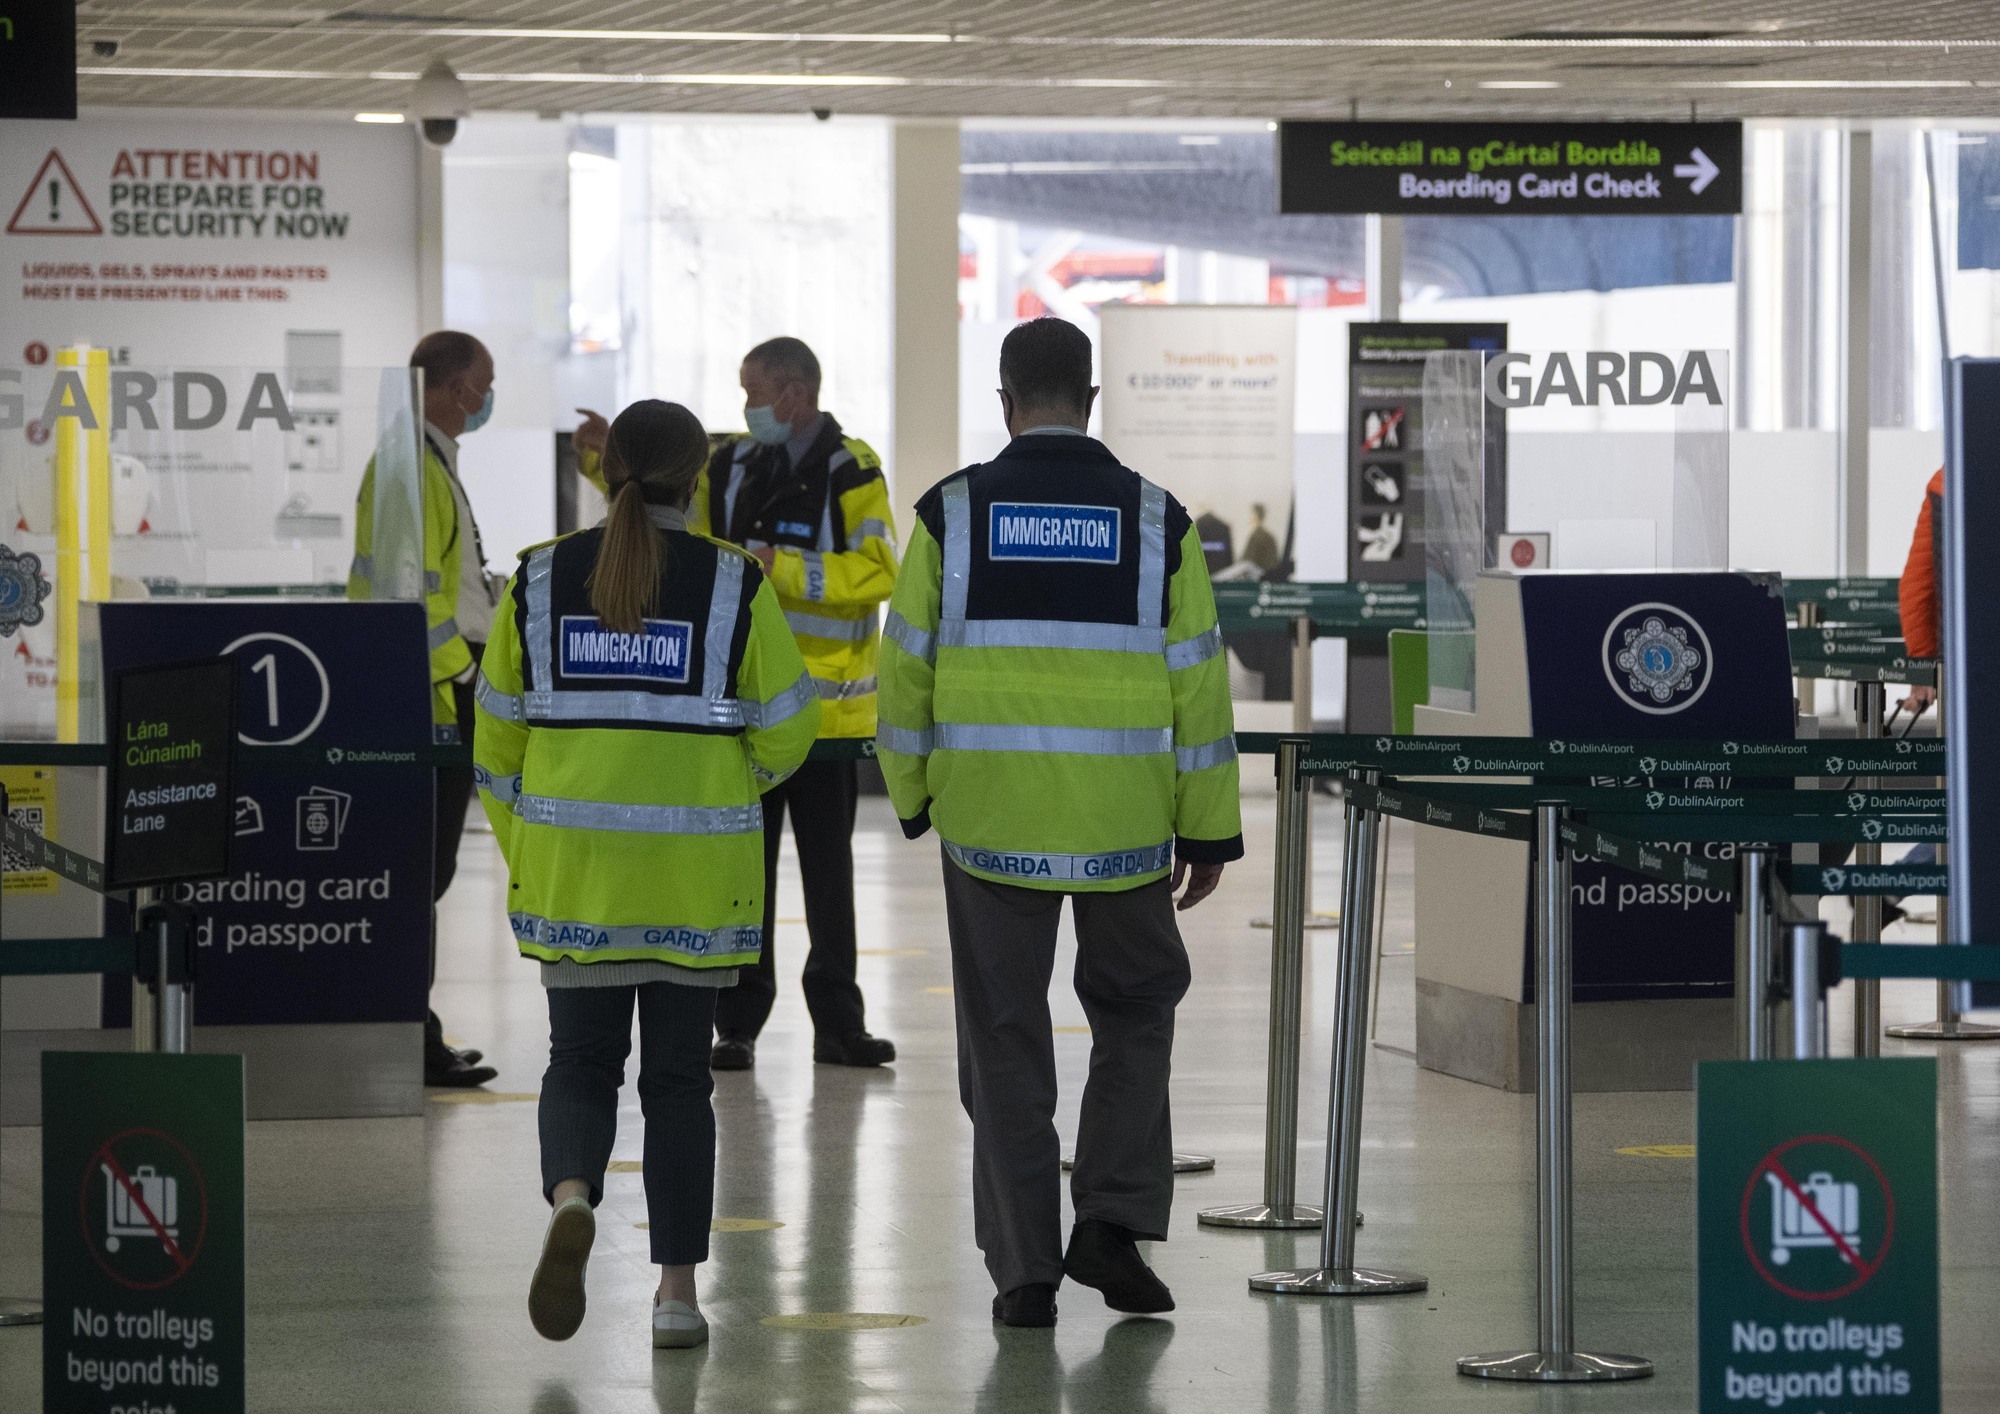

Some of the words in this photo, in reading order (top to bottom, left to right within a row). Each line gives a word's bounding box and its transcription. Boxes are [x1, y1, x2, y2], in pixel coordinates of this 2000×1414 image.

[111, 150, 320, 181] ATTENTION
[1331, 140, 1423, 166] Seiceáil
[1430, 146, 1461, 166] na
[1566, 140, 1661, 166] Bordála
[111, 183, 253, 210] PREPARE
[262, 184, 324, 210] FOR
[1400, 172, 1512, 204] Boarding
[1518, 172, 1578, 198] Card
[1584, 172, 1661, 198] Check
[111, 211, 266, 238] SECURITY
[275, 212, 349, 238] NOW
[22, 263, 95, 282] LIQUIDS,
[151, 265, 219, 281] SPRAYS
[222, 265, 258, 281] AND
[262, 265, 329, 281] PASTES
[22, 285, 73, 300] MUST
[76, 286, 97, 300] BE
[101, 286, 202, 301] PRESENTED
[205, 287, 242, 301] LIKE
[1163, 352, 1238, 368] Travelling
[1244, 353, 1278, 366] with
[1485, 350, 1725, 409] GARDA
[998, 514, 1110, 549] IMMIGRATION
[569, 629, 681, 668] IMMIGRATION
[251, 653, 279, 727] 1
[127, 720, 168, 742] Lána
[126, 742, 202, 767] Cúnaimh
[347, 750, 416, 764] DublinAirport
[1396, 741, 1461, 752] DublinAirport
[1569, 743, 1634, 754] DublinAirport
[1742, 744, 1807, 755] DublinAirport
[1474, 759, 1545, 772] DublinAirport
[1661, 760, 1731, 773] DublinAirport
[1847, 759, 1917, 772] DublinAirport
[124, 782, 217, 809] Assistance
[1668, 795, 1745, 809] DublinAirport
[1870, 796, 1946, 809] DublinAirport
[123, 813, 166, 834] Lane
[1887, 824, 1949, 837] DublinAirp
[972, 851, 1053, 876] GARDA
[1083, 853, 1145, 877] GARDA
[318, 869, 391, 901] card
[1851, 873, 1948, 890] DublinAirport
[1572, 877, 1606, 905] nd
[1618, 884, 1731, 912] passpo
[226, 917, 372, 954] passport
[643, 929, 709, 951] GARD
[72, 1307, 109, 1338] No
[114, 1310, 214, 1350] trolleys
[1731, 1321, 1777, 1353] No
[1781, 1317, 1904, 1358] trolleys
[66, 1352, 163, 1392] beyond
[169, 1357, 220, 1387] this
[1725, 1364, 1844, 1407] beyond
[1848, 1363, 1911, 1396] this
